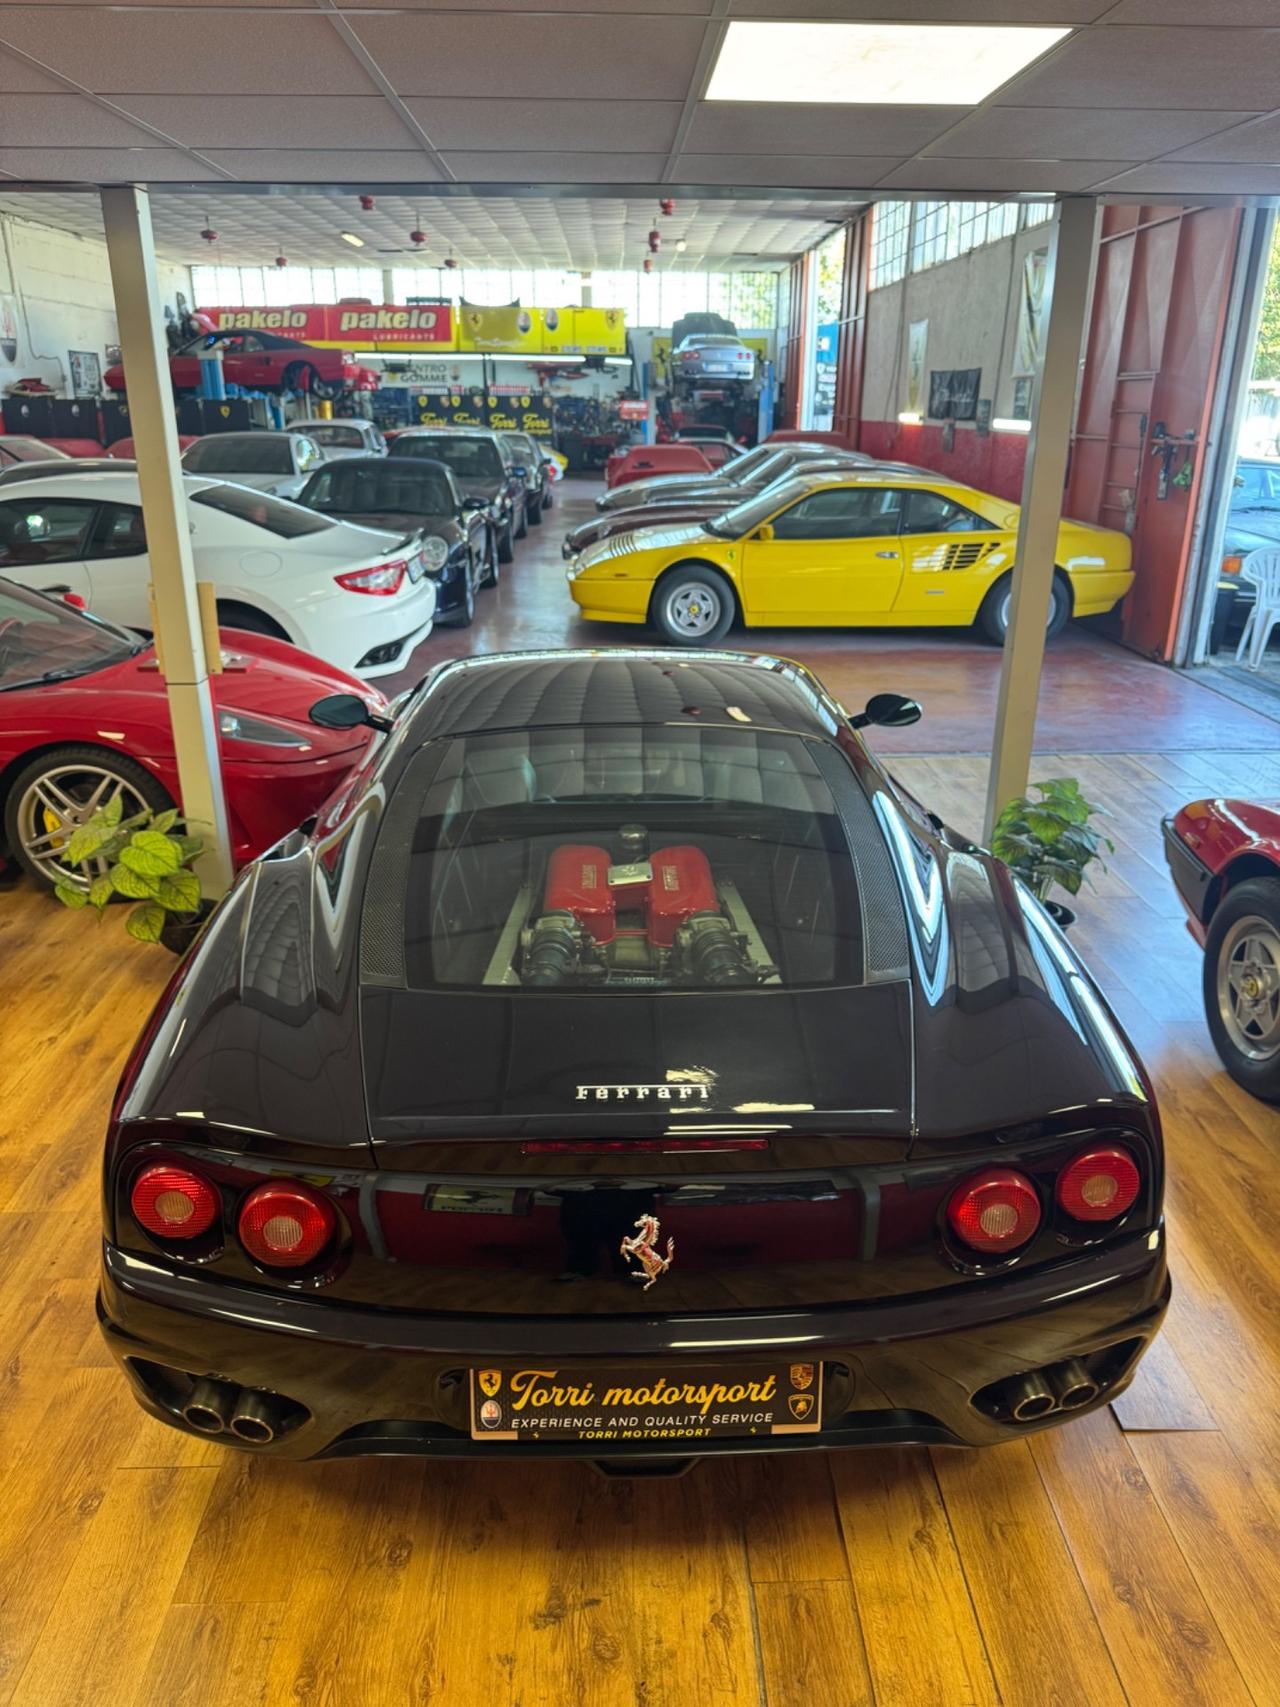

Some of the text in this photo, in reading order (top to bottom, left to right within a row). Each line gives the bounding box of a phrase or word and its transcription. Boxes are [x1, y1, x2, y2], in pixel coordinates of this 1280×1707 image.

[218, 309, 307, 330] pakelo
[340, 309, 438, 331] pakelo
[575, 1084, 709, 1099] Ferrari
[510, 1370, 777, 1415] Torri motorsport
[511, 1412, 774, 1429] EXPERIENCE AND QUALITY SERVICE
[578, 1428, 712, 1439] TORRI MOTORSPORT
